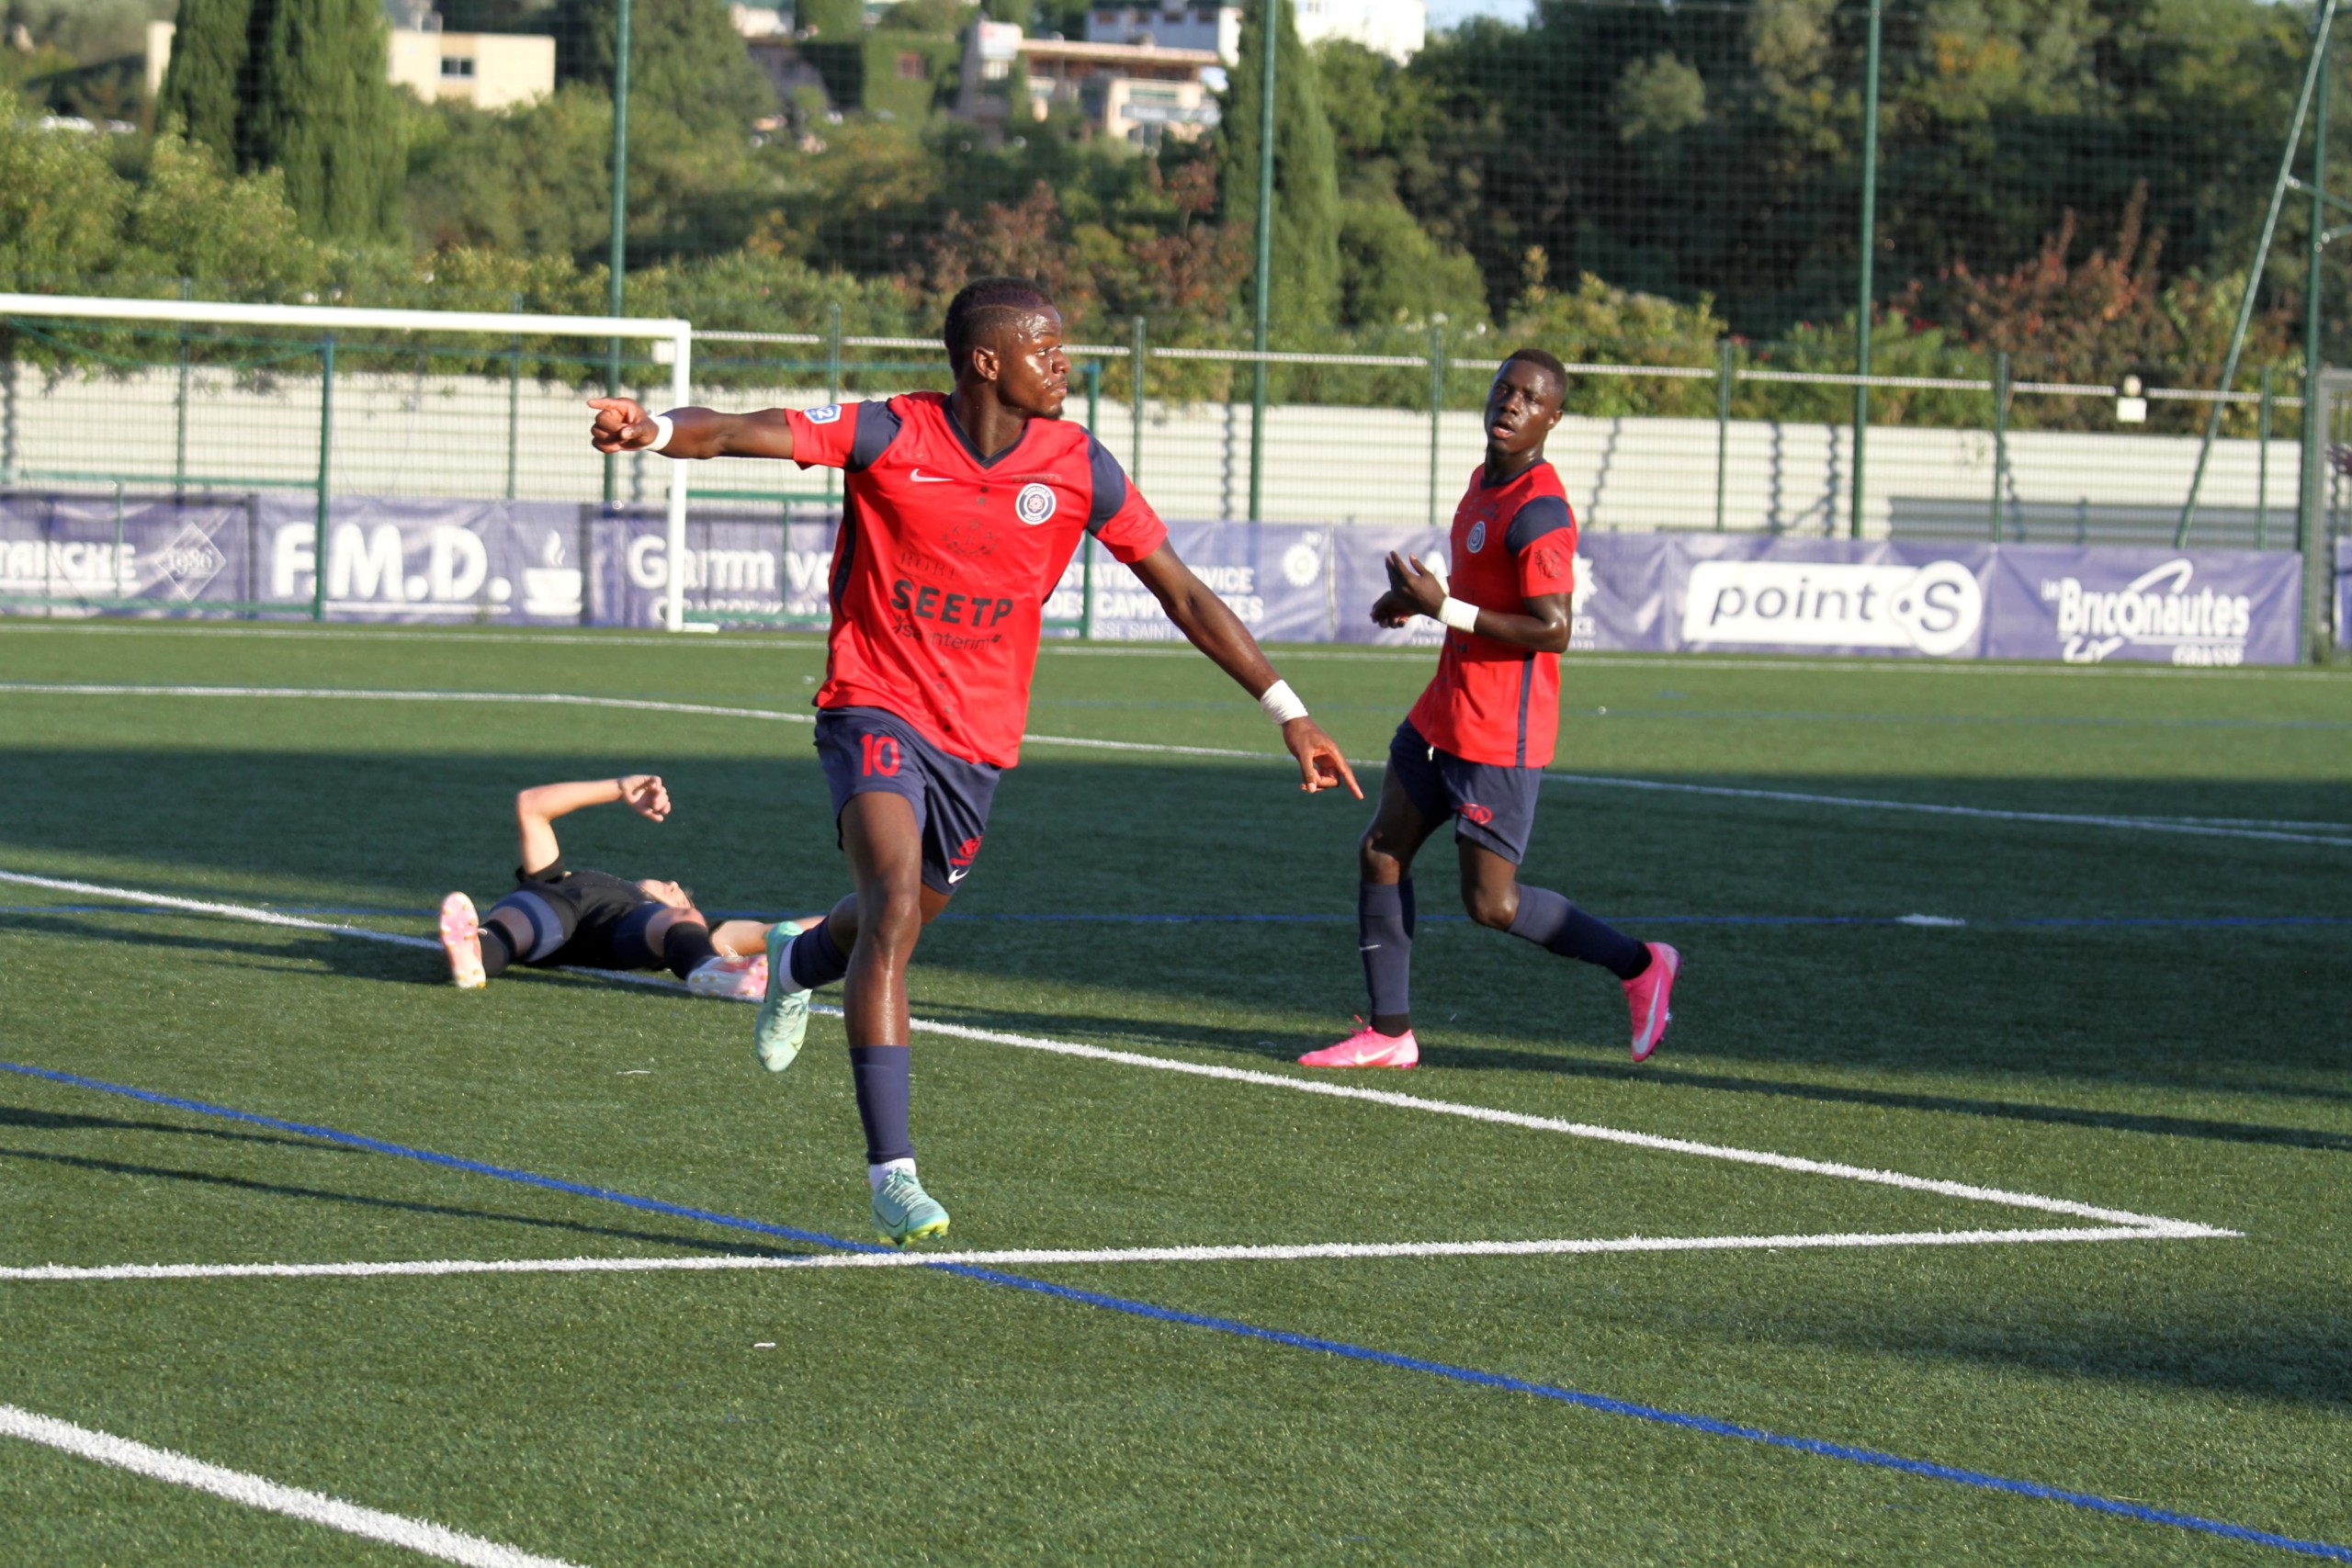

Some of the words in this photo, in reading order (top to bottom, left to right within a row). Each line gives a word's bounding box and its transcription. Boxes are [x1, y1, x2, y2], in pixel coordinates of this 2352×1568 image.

[166, 547, 213, 576] 1986
[273, 521, 513, 603] F.M.D.
[890, 579, 1013, 627] SEETP
[1710, 576, 1877, 627] point
[860, 733, 900, 777] 10
